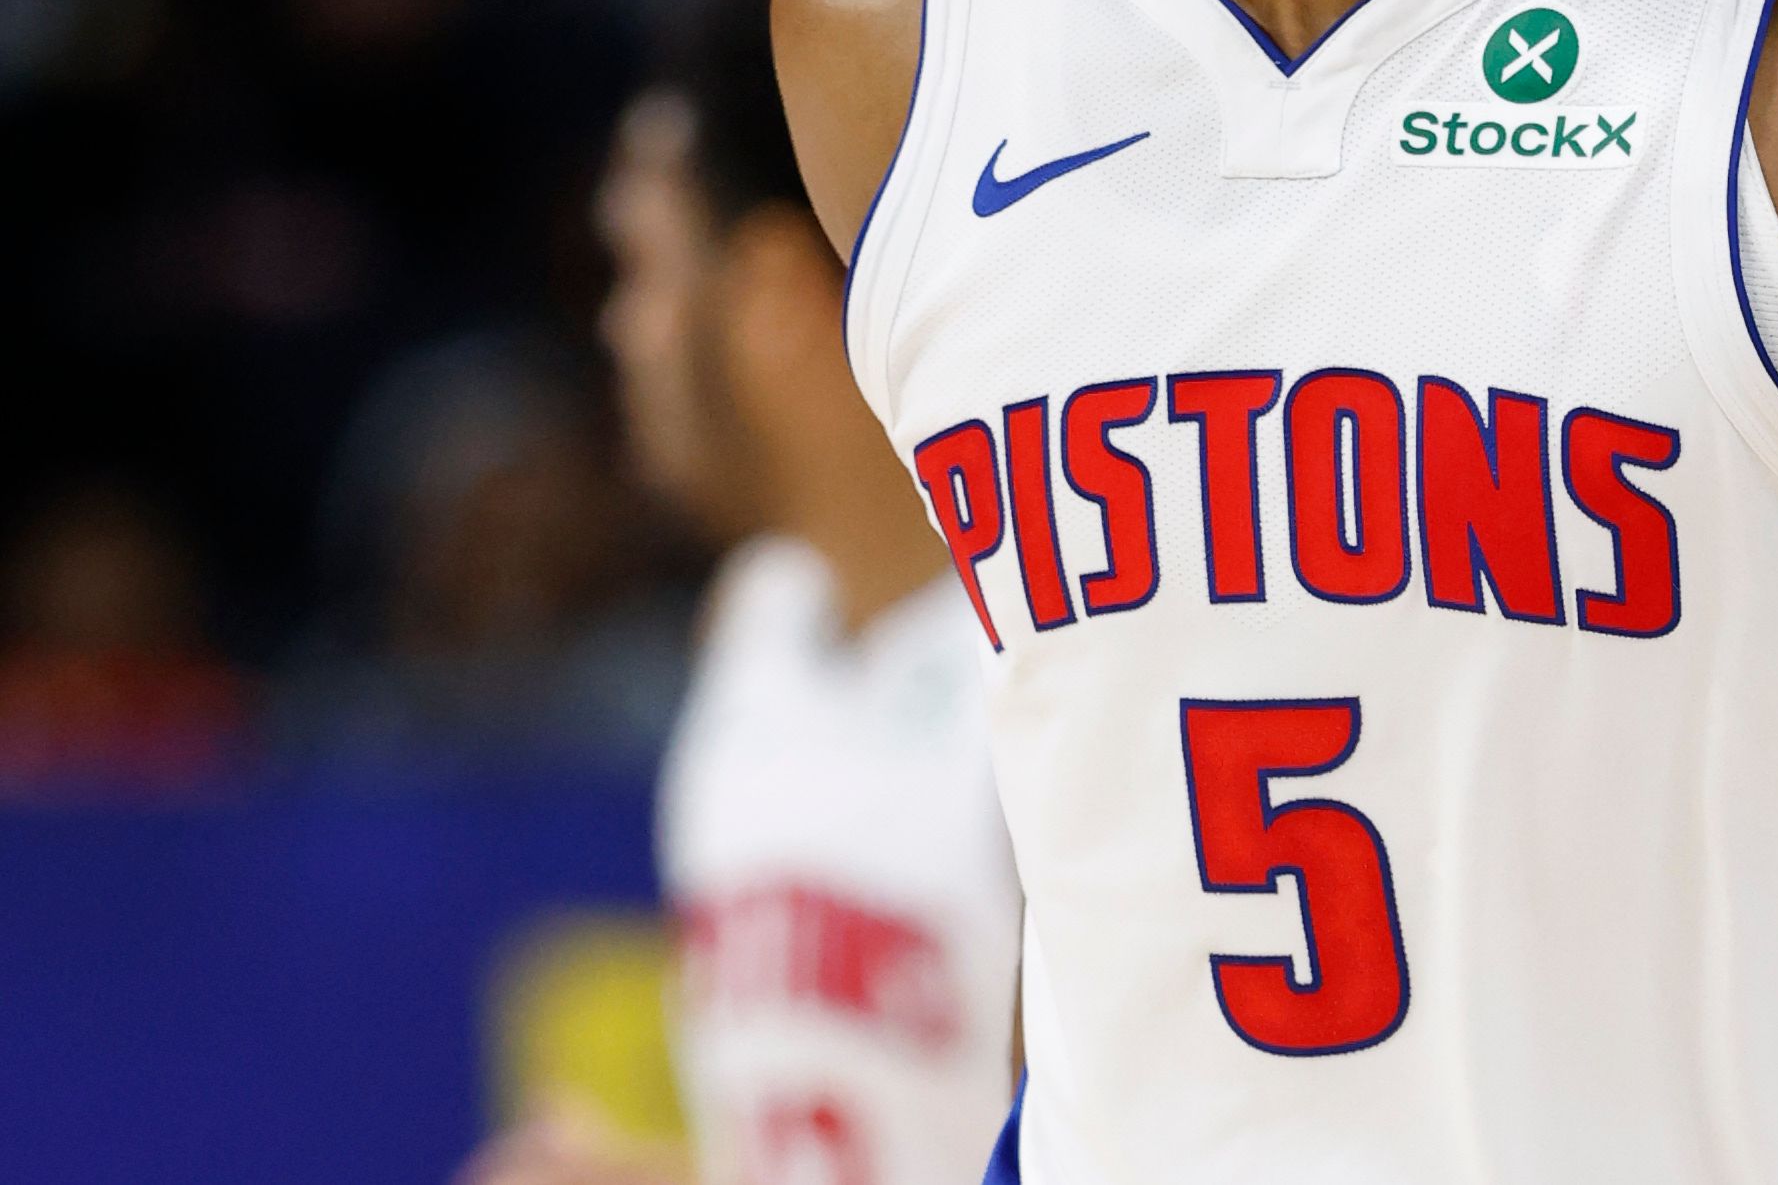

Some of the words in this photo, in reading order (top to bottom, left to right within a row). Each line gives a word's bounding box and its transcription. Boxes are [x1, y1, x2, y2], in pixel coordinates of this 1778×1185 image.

[1399, 111, 1638, 158] StockX
[913, 367, 1682, 654] PISTONS
[1180, 697, 1411, 1056] 5
